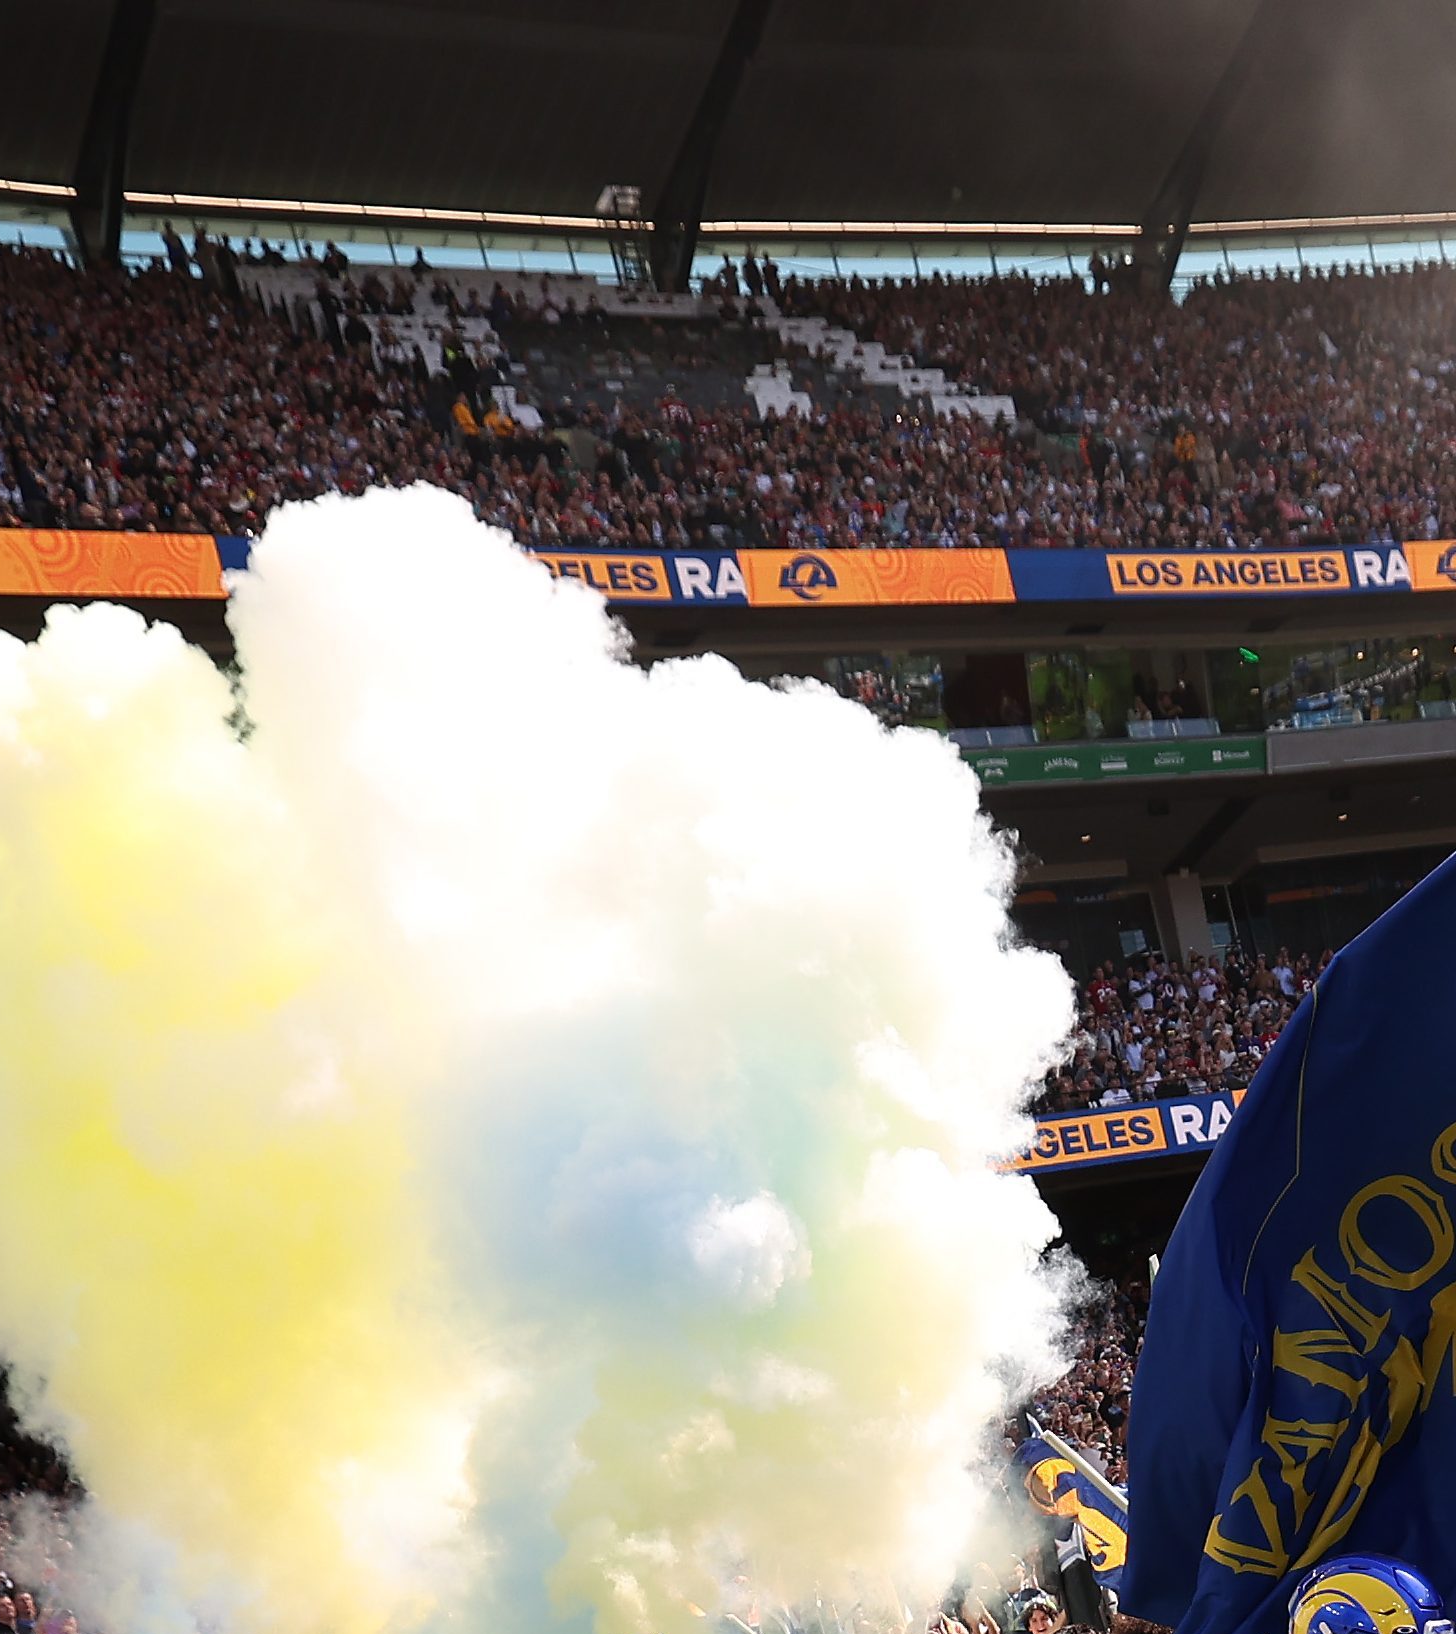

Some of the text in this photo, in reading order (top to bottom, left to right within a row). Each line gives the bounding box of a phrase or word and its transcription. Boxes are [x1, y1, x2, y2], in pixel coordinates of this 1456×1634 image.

[674, 556, 748, 599] RA
[1116, 549, 1411, 587] LOS ANGELES RA
